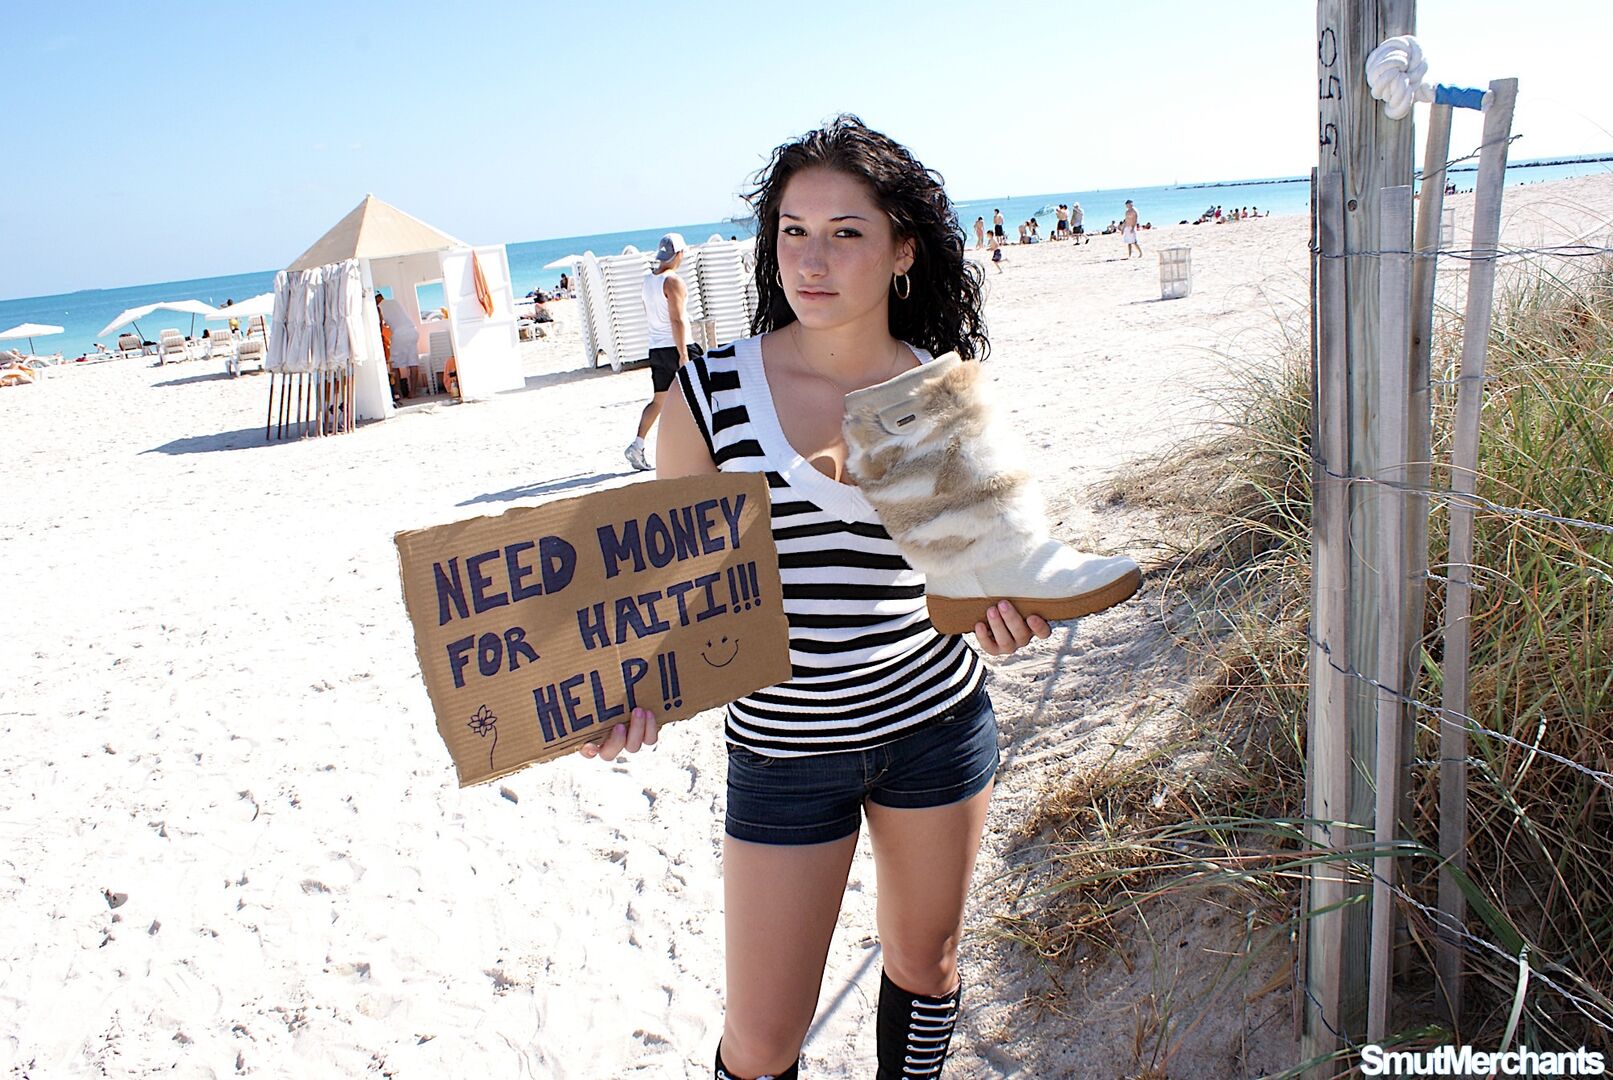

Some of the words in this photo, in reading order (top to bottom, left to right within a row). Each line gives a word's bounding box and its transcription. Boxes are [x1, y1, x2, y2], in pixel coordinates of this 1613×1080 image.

[433, 535, 577, 626] NEED
[596, 493, 746, 579] MONEY
[446, 626, 540, 689] FOR
[576, 560, 762, 650] HAITI!!!
[533, 651, 683, 743] HELP!!
